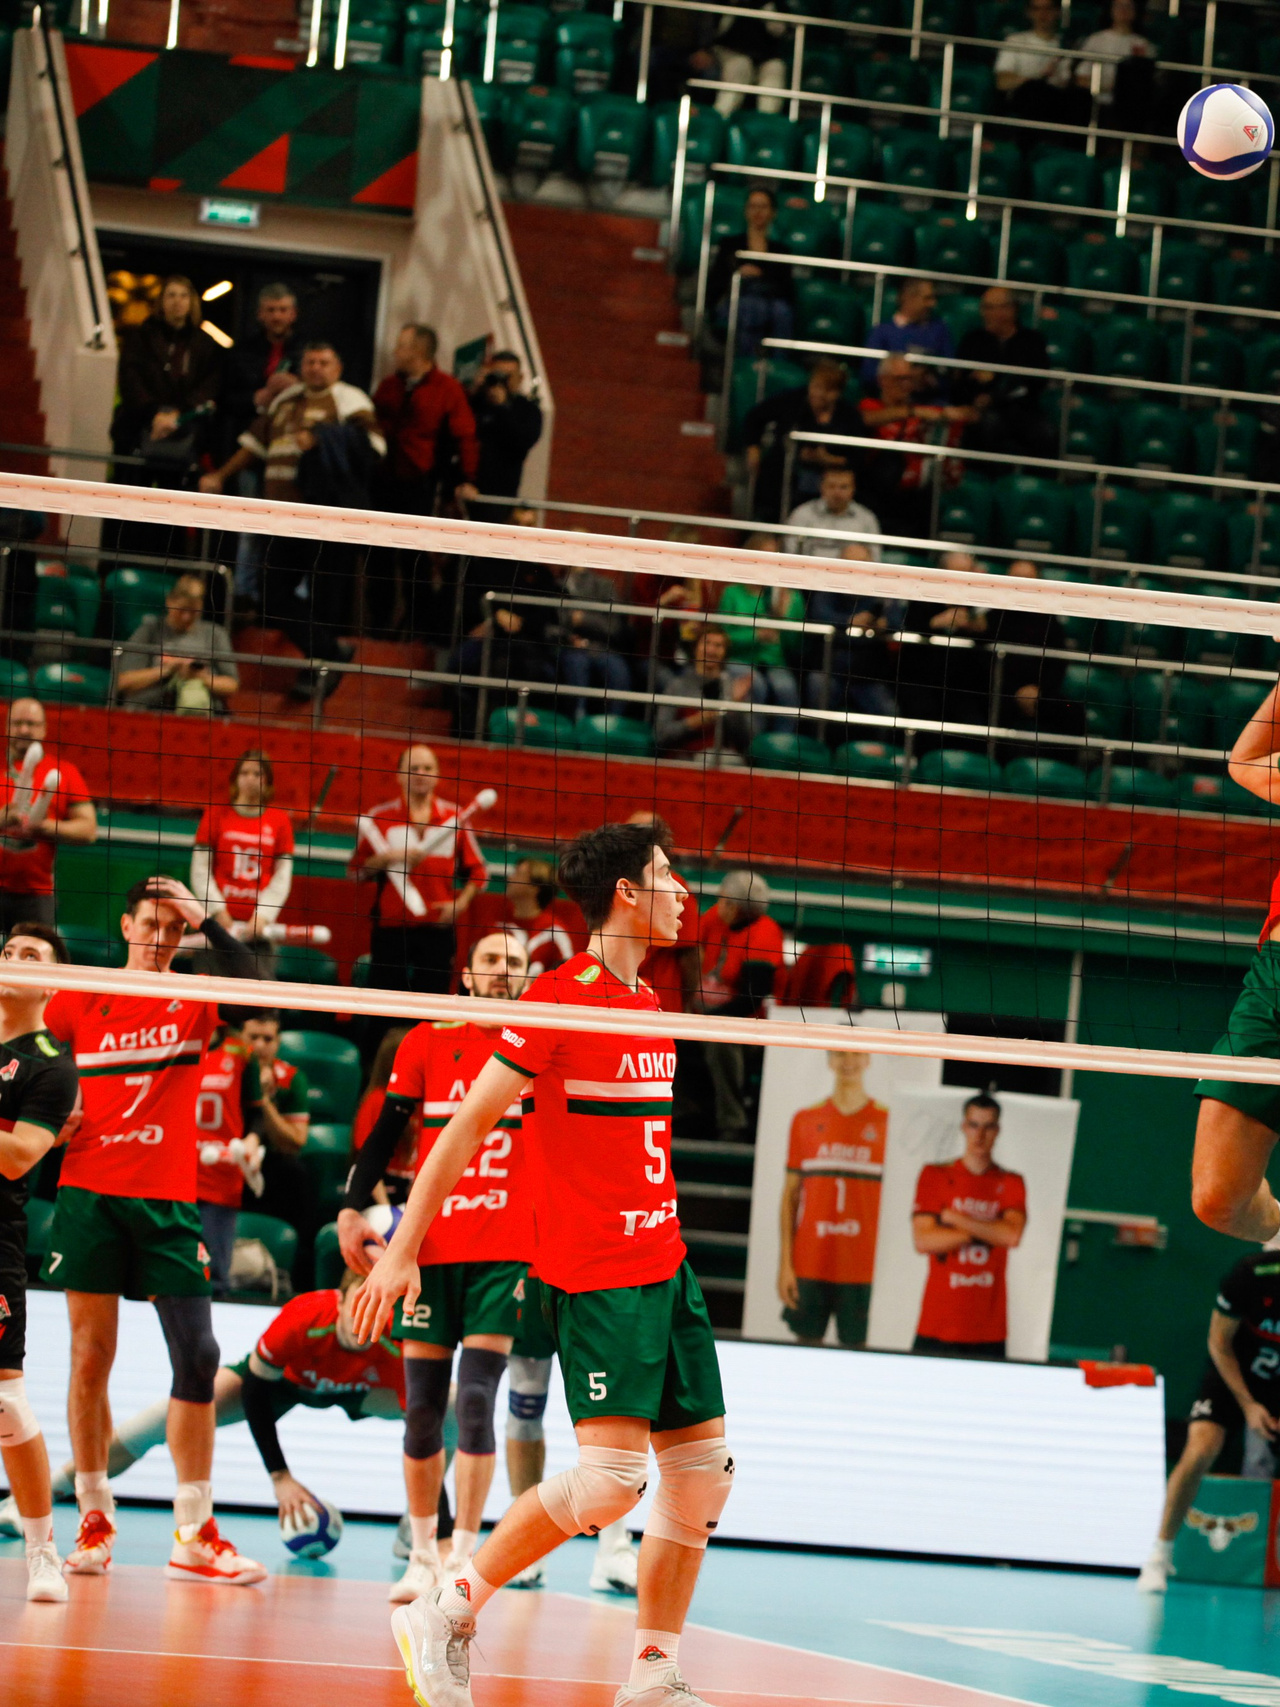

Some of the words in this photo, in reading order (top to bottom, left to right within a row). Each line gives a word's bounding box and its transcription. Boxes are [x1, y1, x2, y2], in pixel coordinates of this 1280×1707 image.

[99, 1023, 178, 1051] ЛОКО
[615, 1052, 677, 1079] ЛОКО
[122, 1074, 152, 1119] 7
[644, 1120, 666, 1184] 5
[835, 1177, 847, 1213] 1
[50, 1252, 63, 1274] 7
[958, 1245, 990, 1265] 10
[588, 1371, 607, 1401] 5
